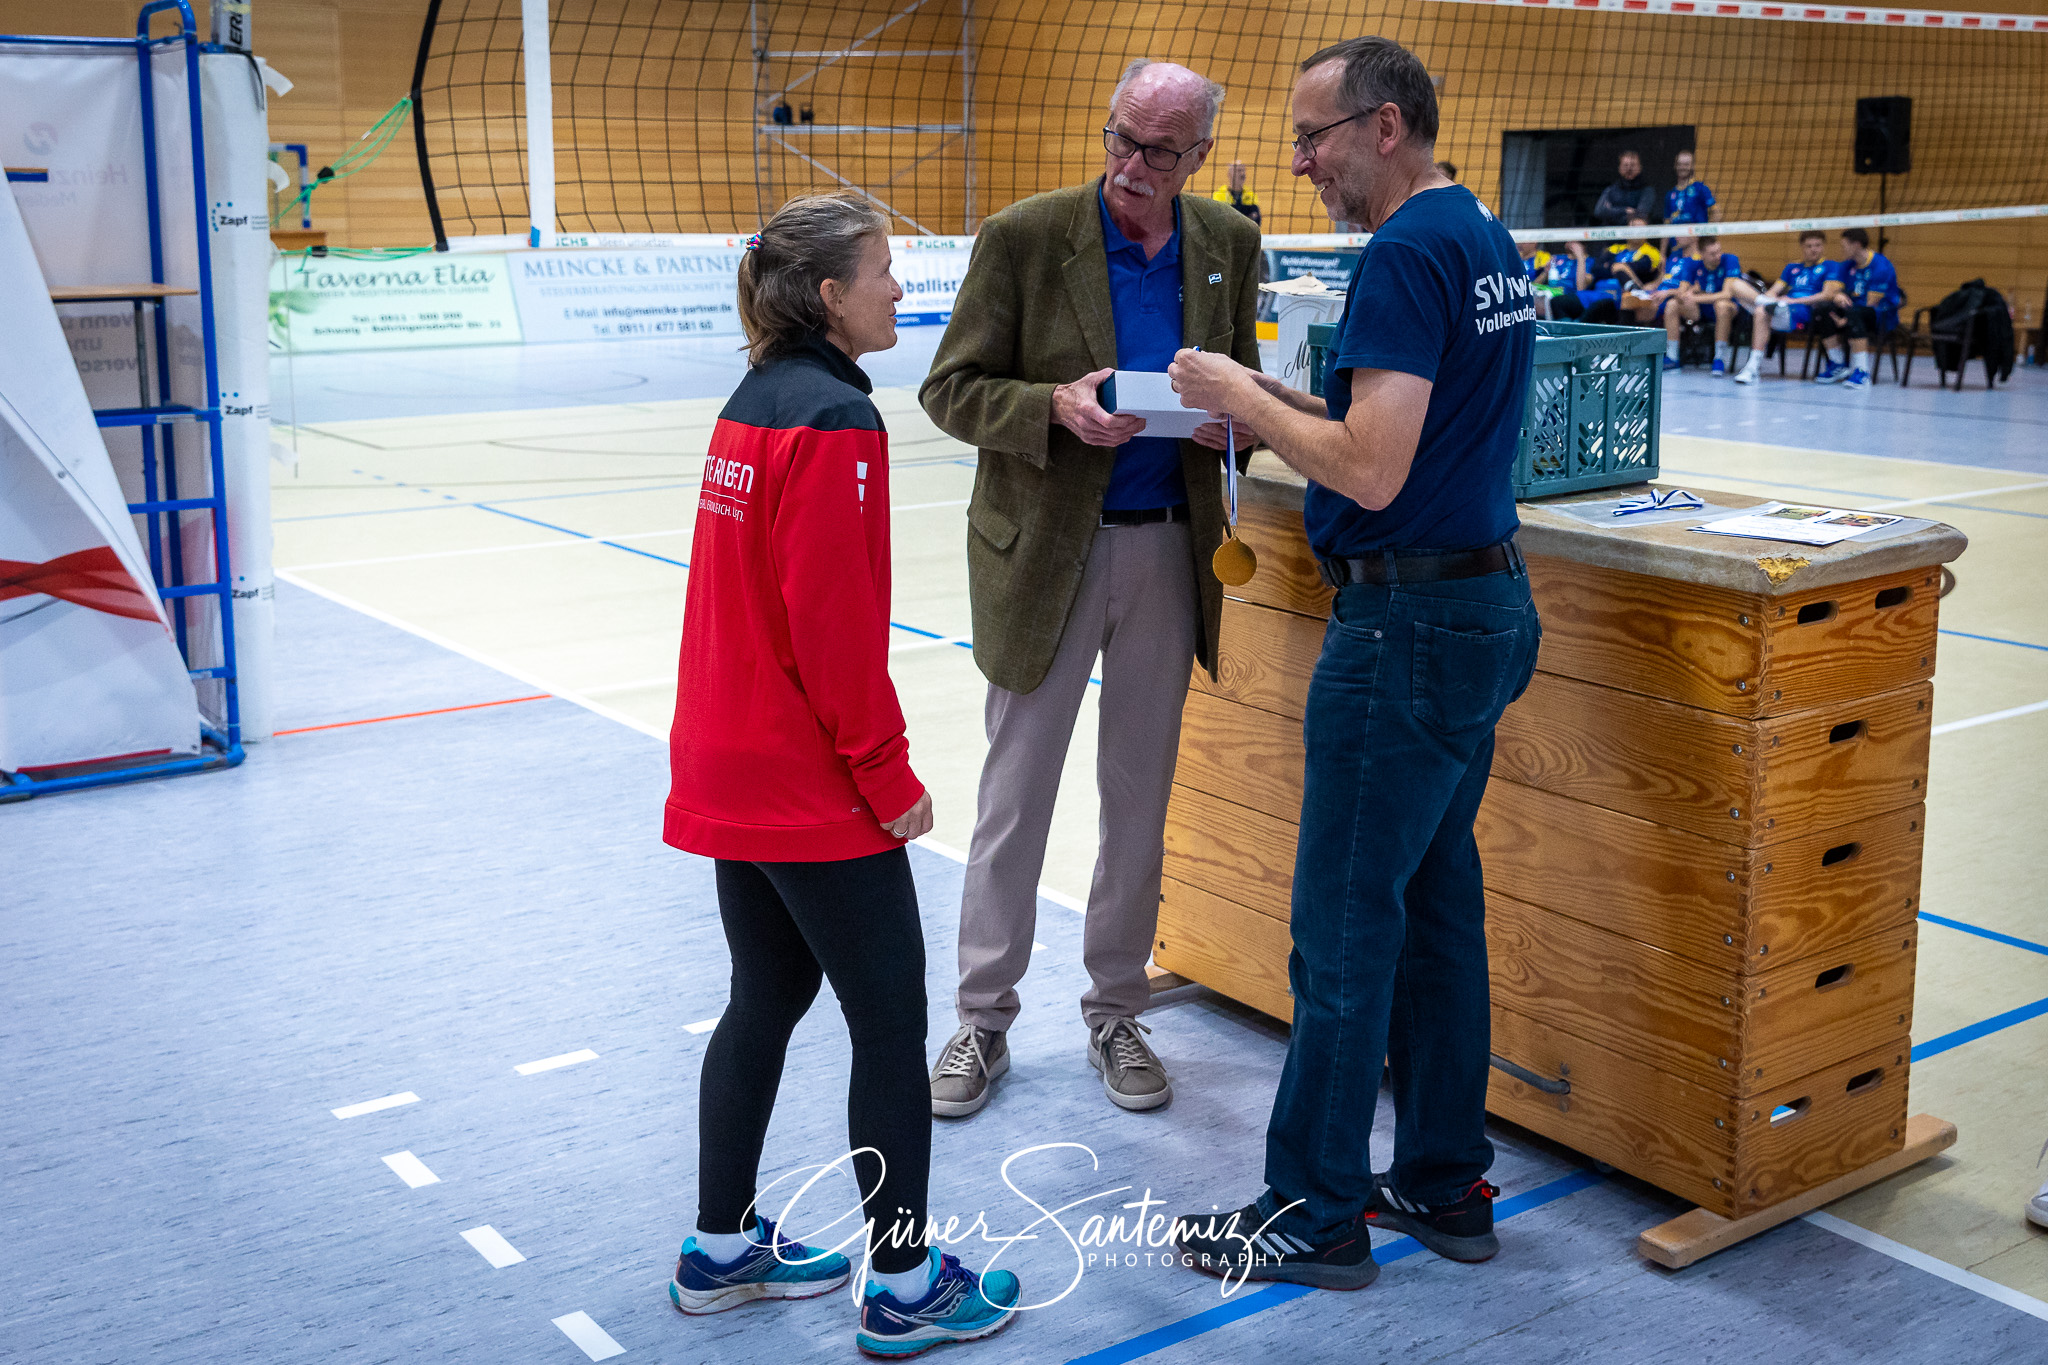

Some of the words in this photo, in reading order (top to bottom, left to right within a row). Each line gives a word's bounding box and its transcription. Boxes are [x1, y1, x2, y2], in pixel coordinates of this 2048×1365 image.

[219, 215, 248, 228] Zapf
[524, 255, 628, 279] MEINCKE
[633, 256, 650, 276] &
[301, 267, 430, 289] Taverna
[433, 262, 495, 287] Elia
[225, 405, 254, 416] Zapf
[231, 587, 260, 599] Zapf
